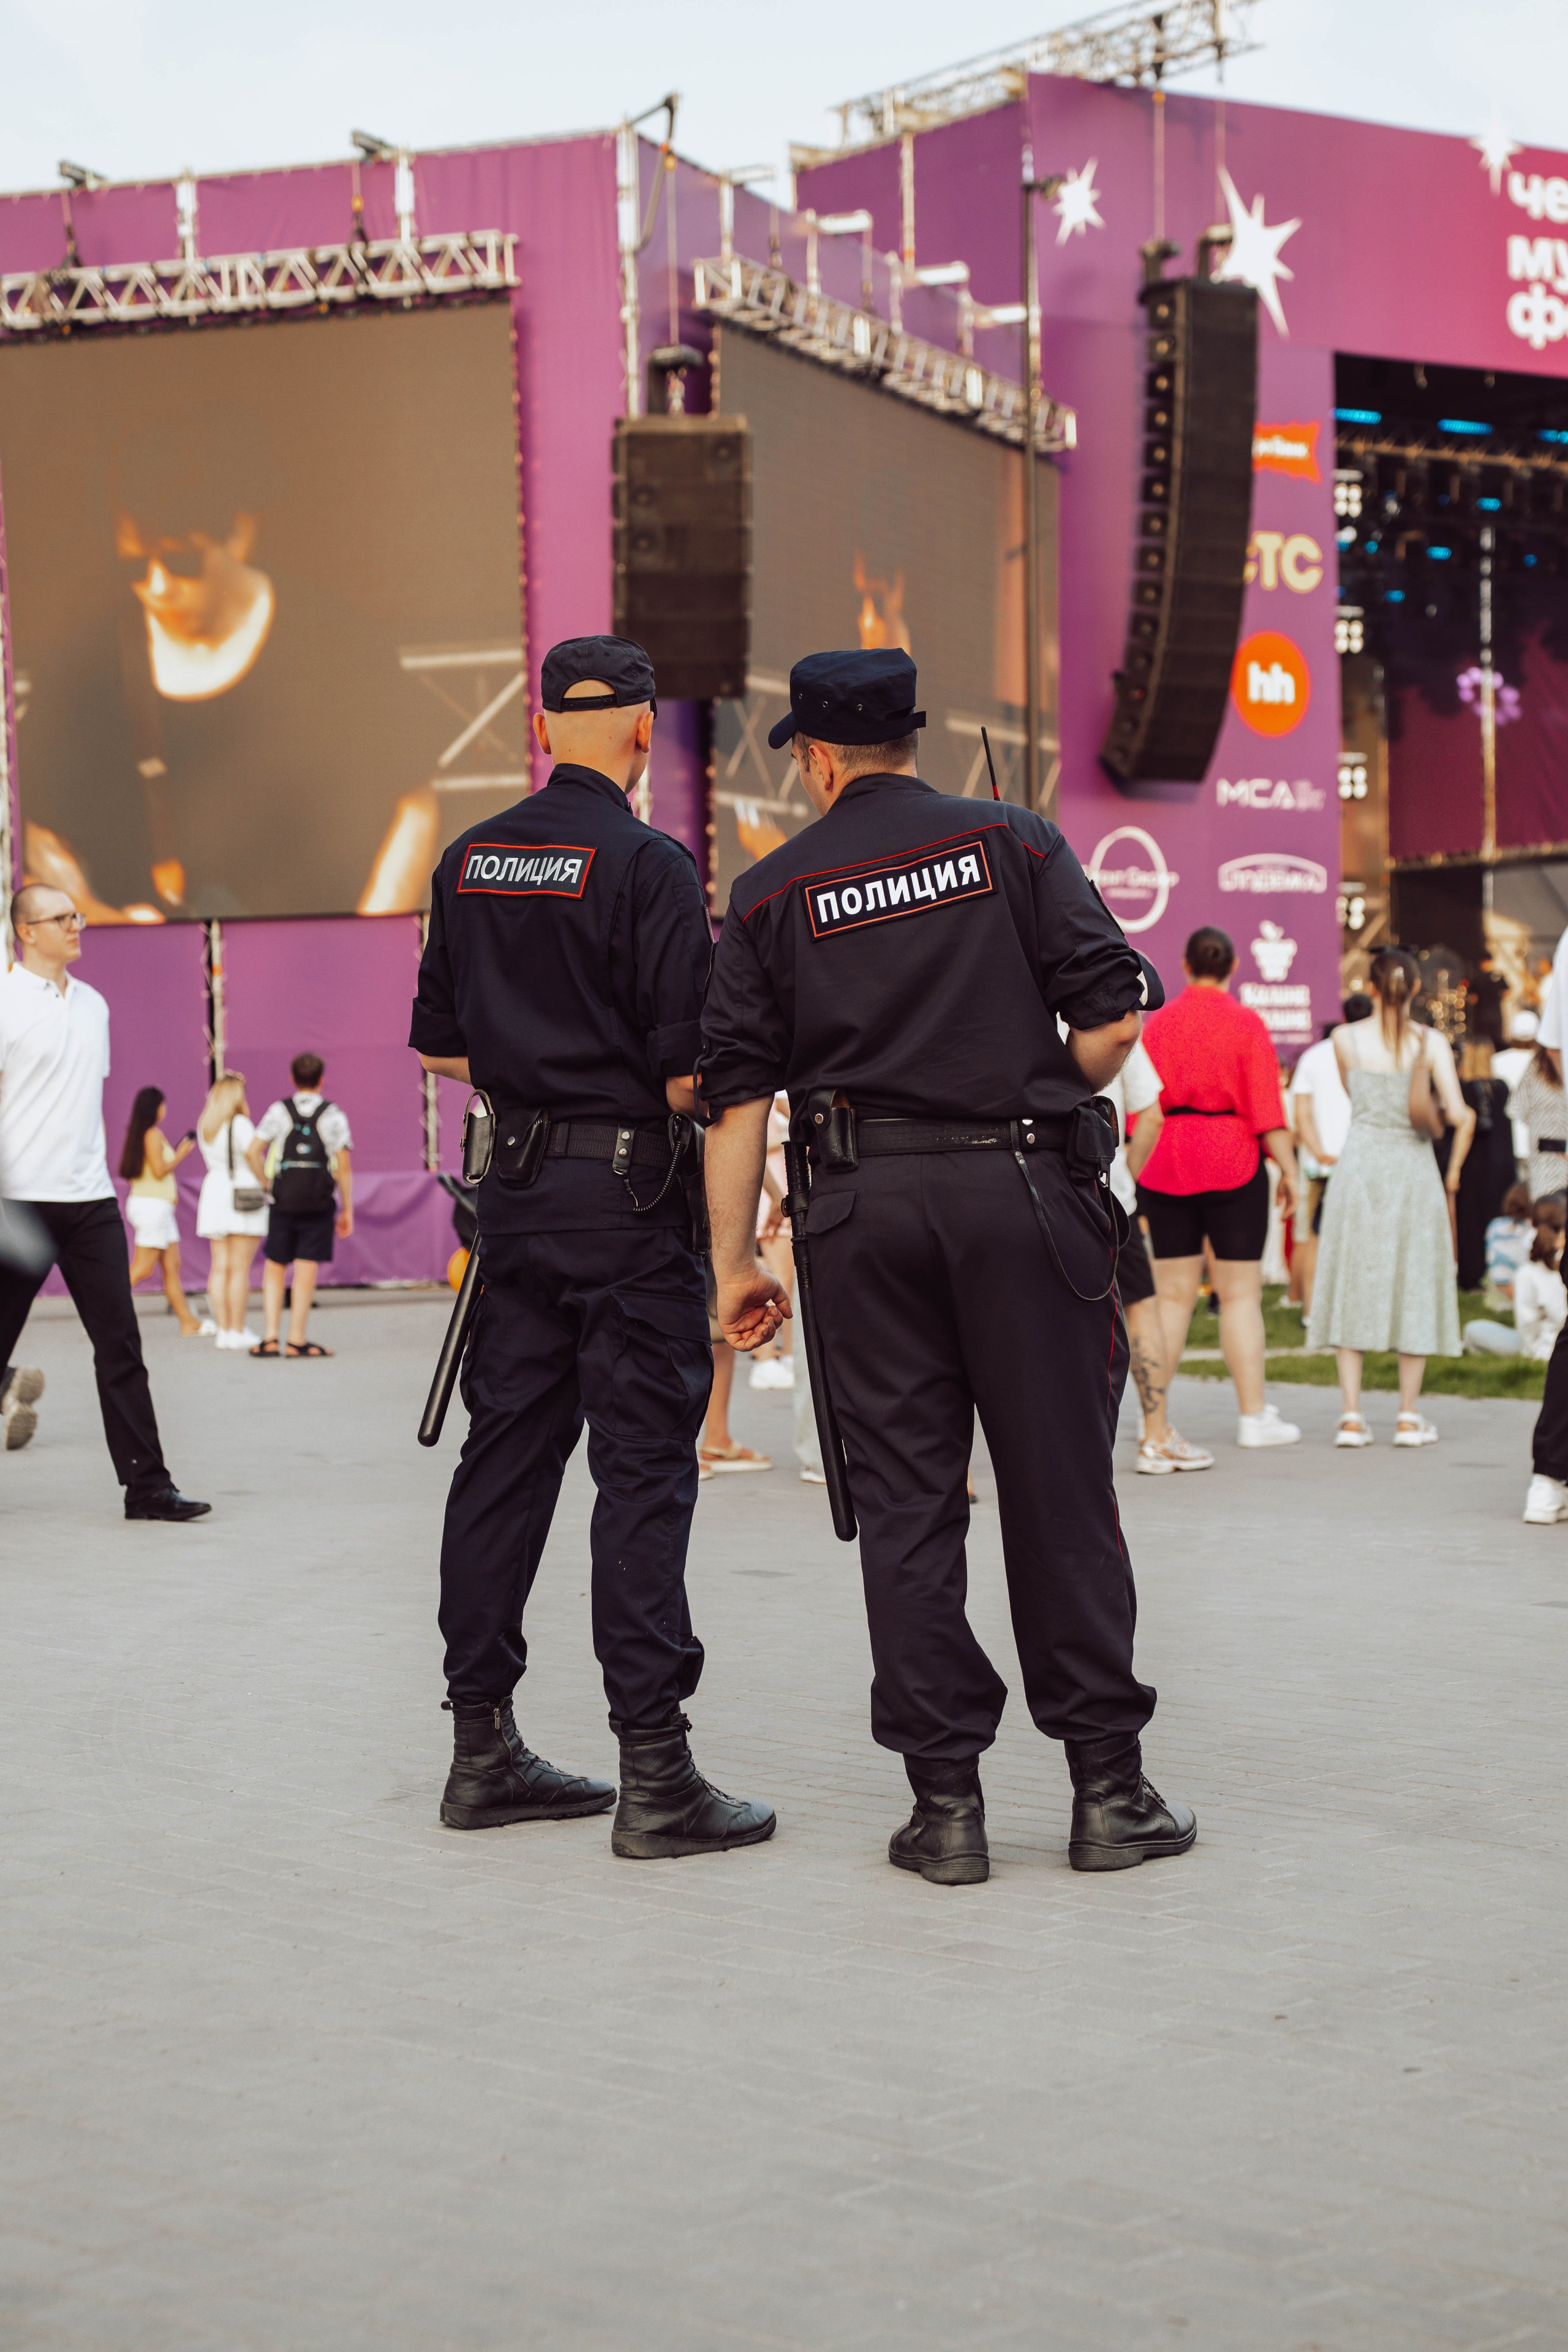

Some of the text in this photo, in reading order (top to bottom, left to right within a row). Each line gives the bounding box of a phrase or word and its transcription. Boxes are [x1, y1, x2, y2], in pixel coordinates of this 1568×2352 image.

[1507, 282, 1568, 350] ф
[1244, 531, 1322, 594] ТС
[1248, 662, 1295, 705] hh
[466, 855, 582, 885] ПОЛИЦИЯ
[816, 854, 981, 923] ПОЛИЦИЯ
